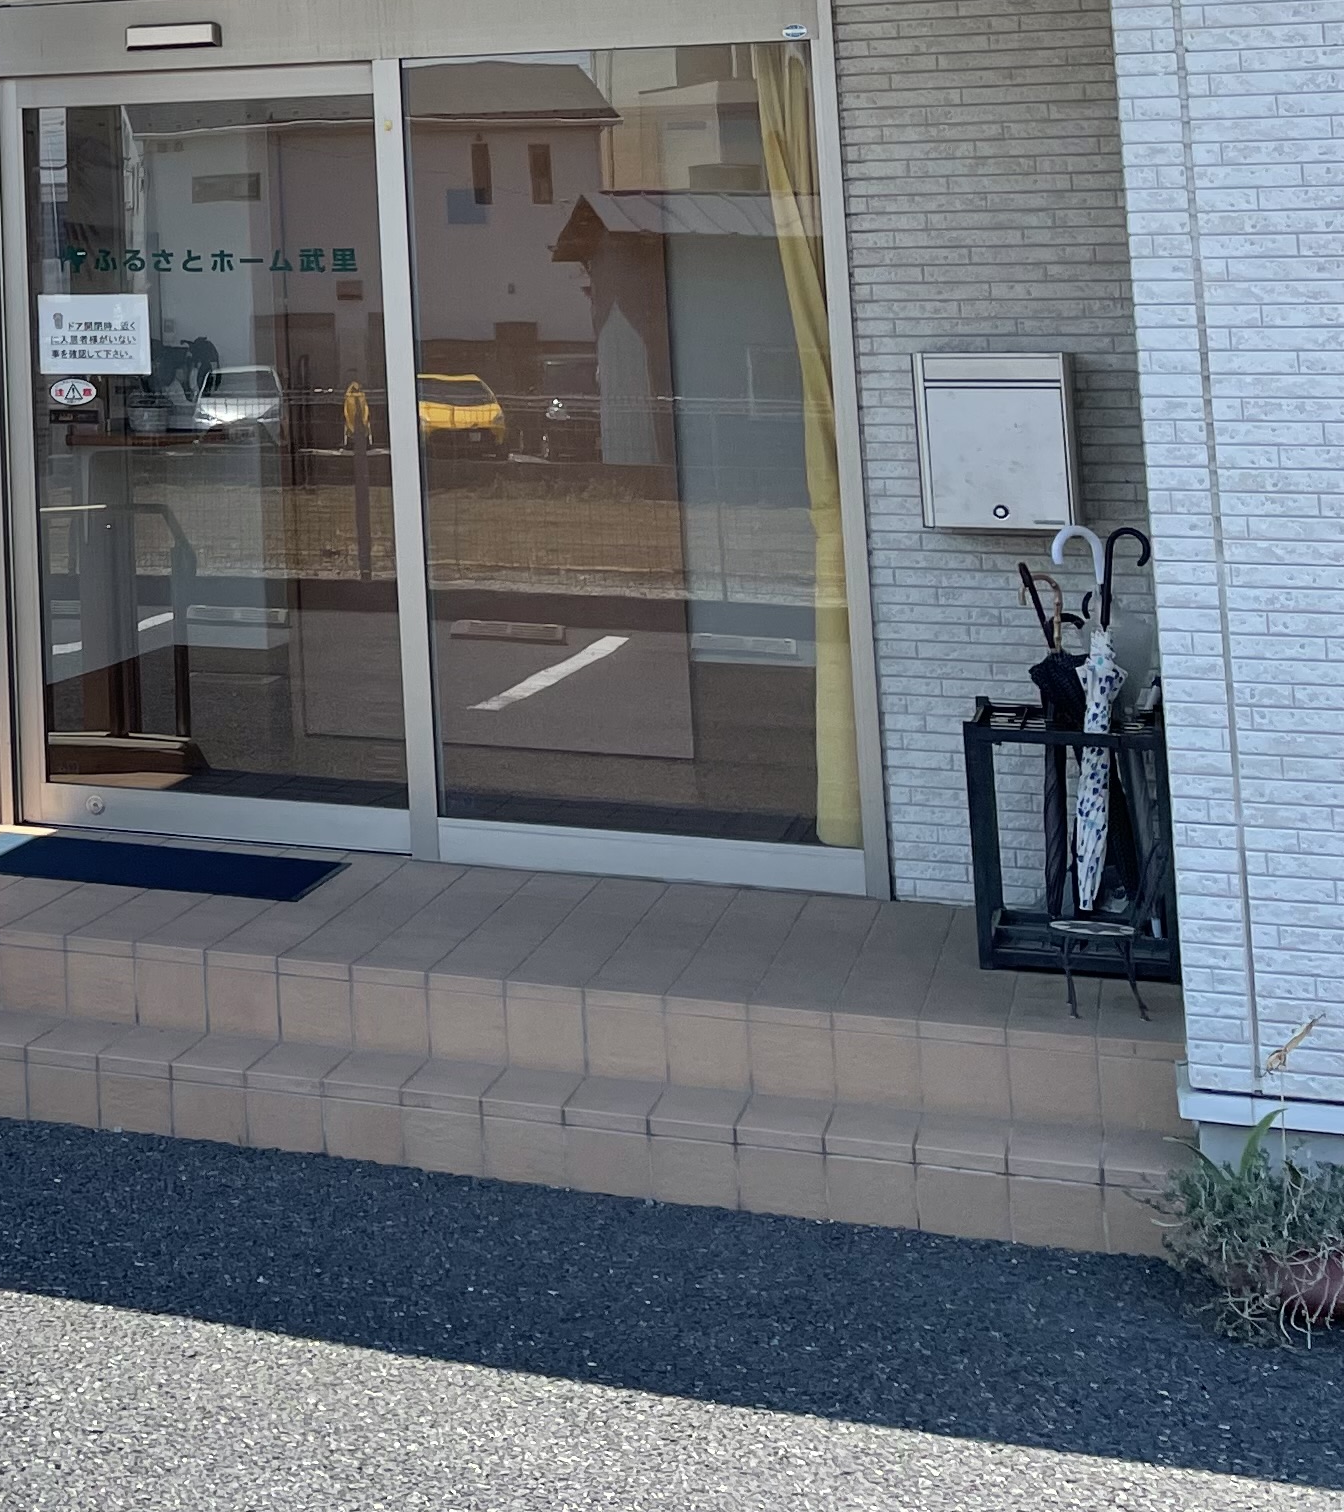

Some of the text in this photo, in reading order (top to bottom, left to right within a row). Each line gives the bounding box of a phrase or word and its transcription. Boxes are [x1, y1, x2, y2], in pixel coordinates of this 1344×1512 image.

[94, 248, 358, 273] ふるさとホーム武里
